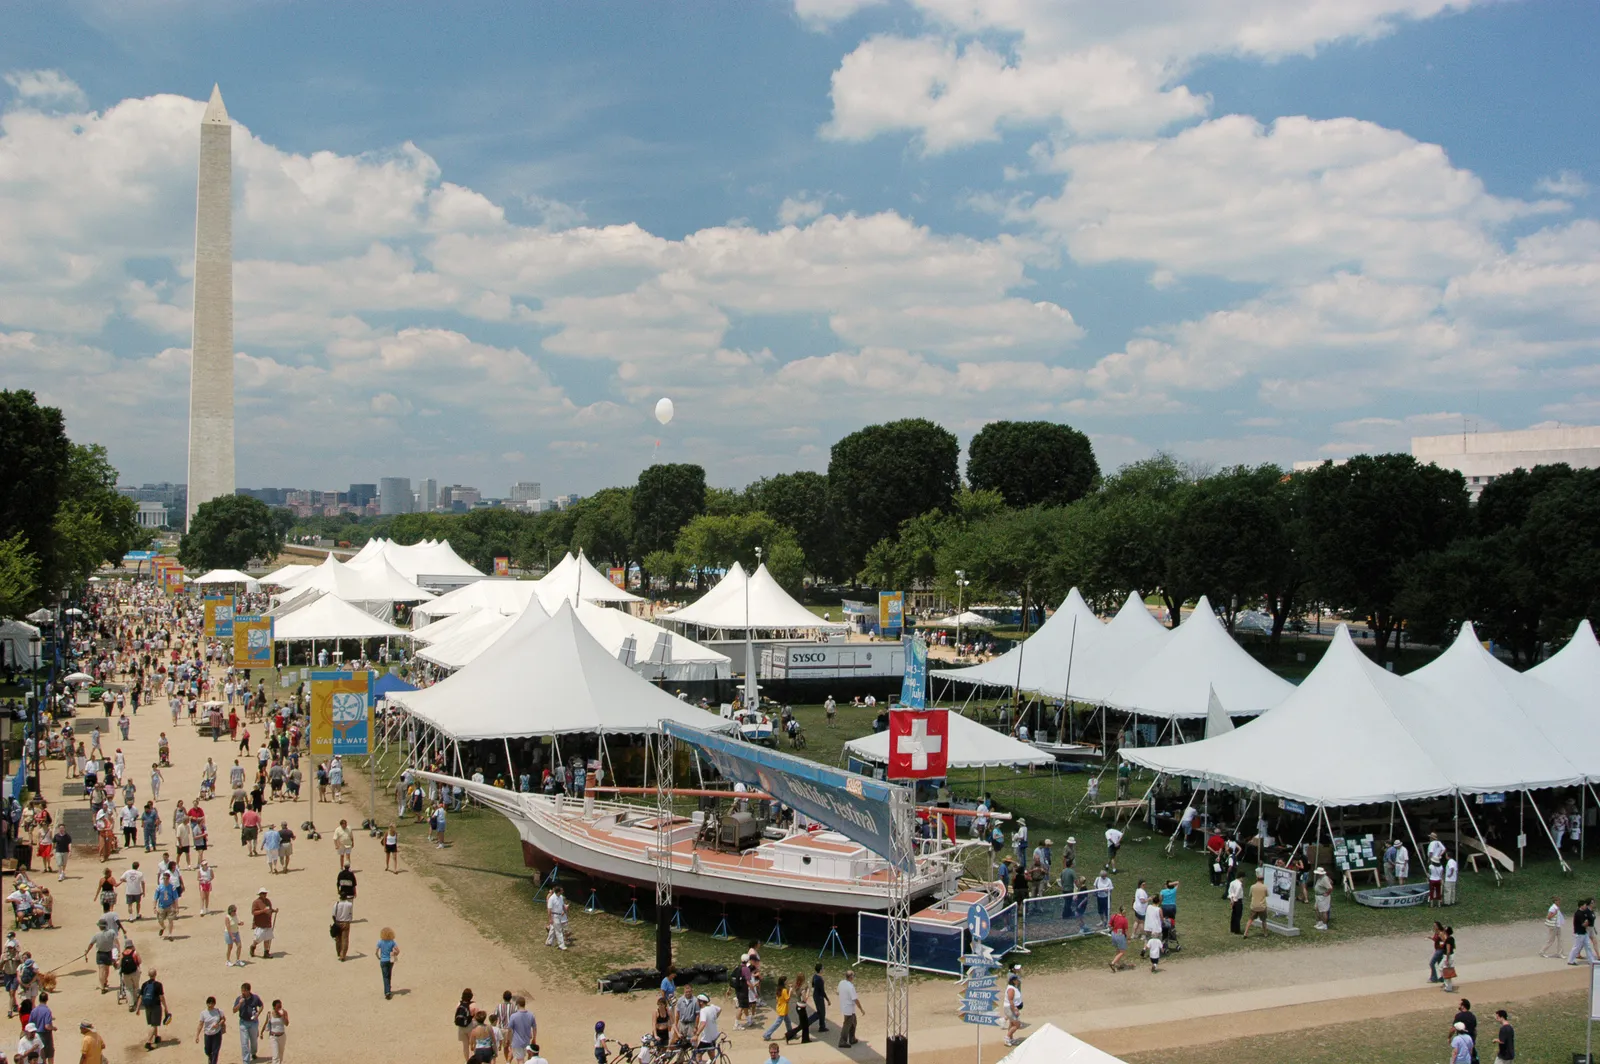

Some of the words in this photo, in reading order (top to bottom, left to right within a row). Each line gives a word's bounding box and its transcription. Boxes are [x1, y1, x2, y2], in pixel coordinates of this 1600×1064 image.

[792, 652, 826, 663] SYSCO
[316, 736, 342, 745] WATER
[346, 736, 368, 745] WAYS
[783, 773, 831, 810] Folklife
[825, 792, 880, 836] Festival
[1393, 895, 1424, 905] POLICE
[968, 980, 982, 988] FIRST
[968, 991, 992, 999] METRO
[967, 1014, 993, 1024] TOILETS
